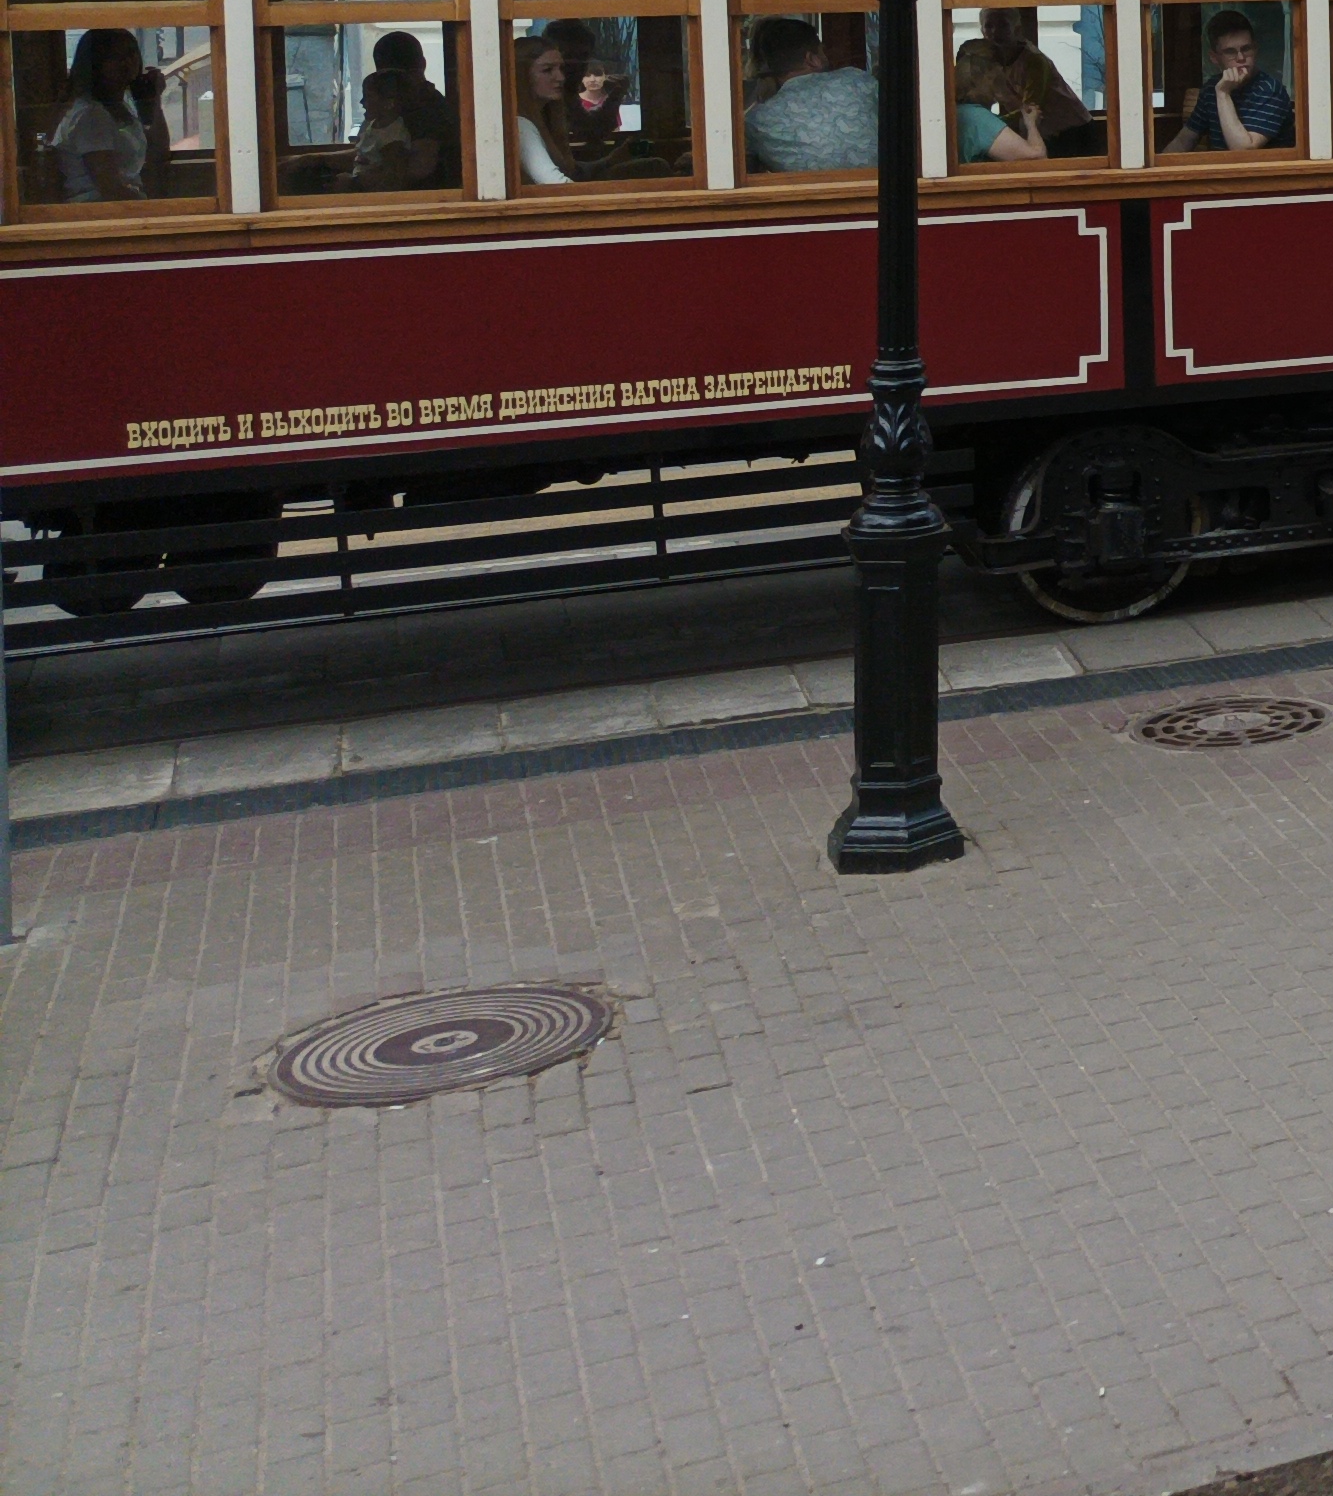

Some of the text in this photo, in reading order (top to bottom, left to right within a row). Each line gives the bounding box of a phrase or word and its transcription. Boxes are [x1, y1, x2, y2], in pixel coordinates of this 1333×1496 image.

[126, 364, 852, 450] ВХОДИТЬ И ВЫХОДИТЬ ВО ВРЕМЯ ДВИЖЕНИЯ ВАГОНА ЗАПРЕЩАЕТСЯ!
